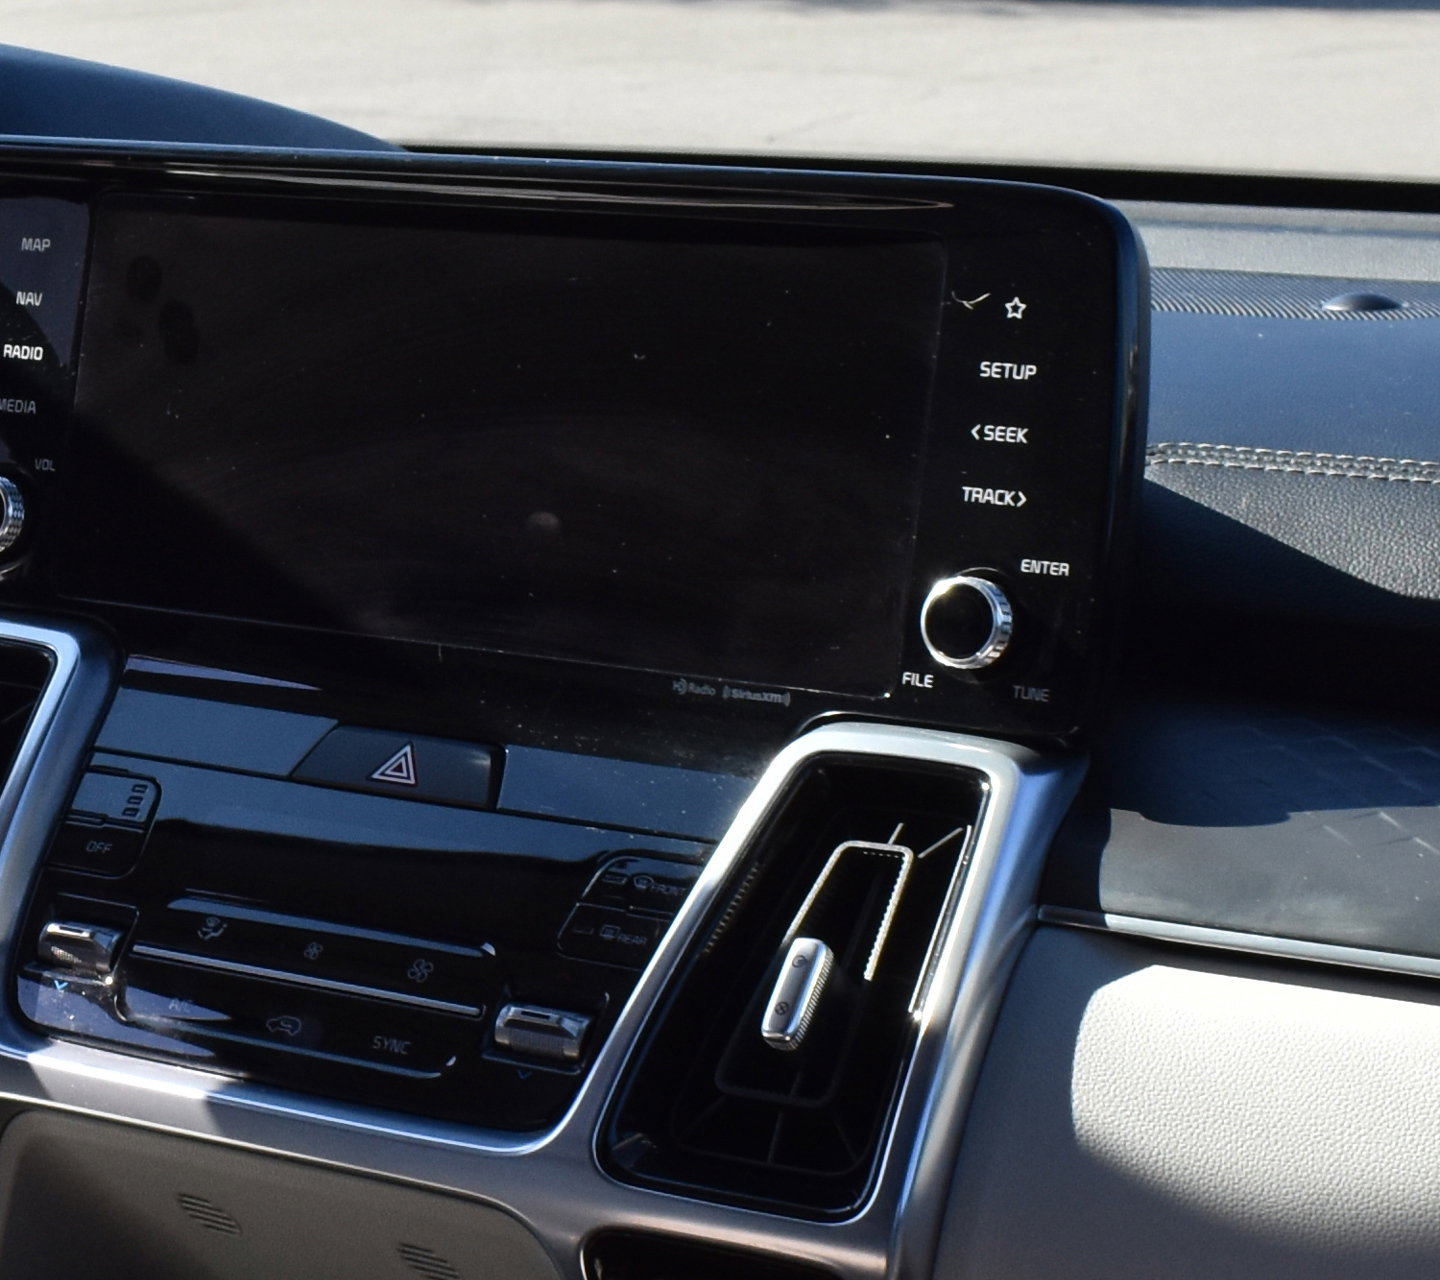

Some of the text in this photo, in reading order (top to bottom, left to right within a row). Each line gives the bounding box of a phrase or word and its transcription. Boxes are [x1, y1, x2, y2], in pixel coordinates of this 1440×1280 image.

[21, 237, 51, 253] MAP
[16, 291, 44, 307] NAV
[3, 344, 44, 361] RADIO
[979, 360, 1037, 381] SETUP
[34, 457, 57, 472] VOL
[1020, 558, 1070, 578] ENTER
[901, 671, 934, 690] FILE
[1012, 685, 1050, 703] TUNE
[85, 840, 113, 854] OFF
[371, 1034, 412, 1056] SYNC
